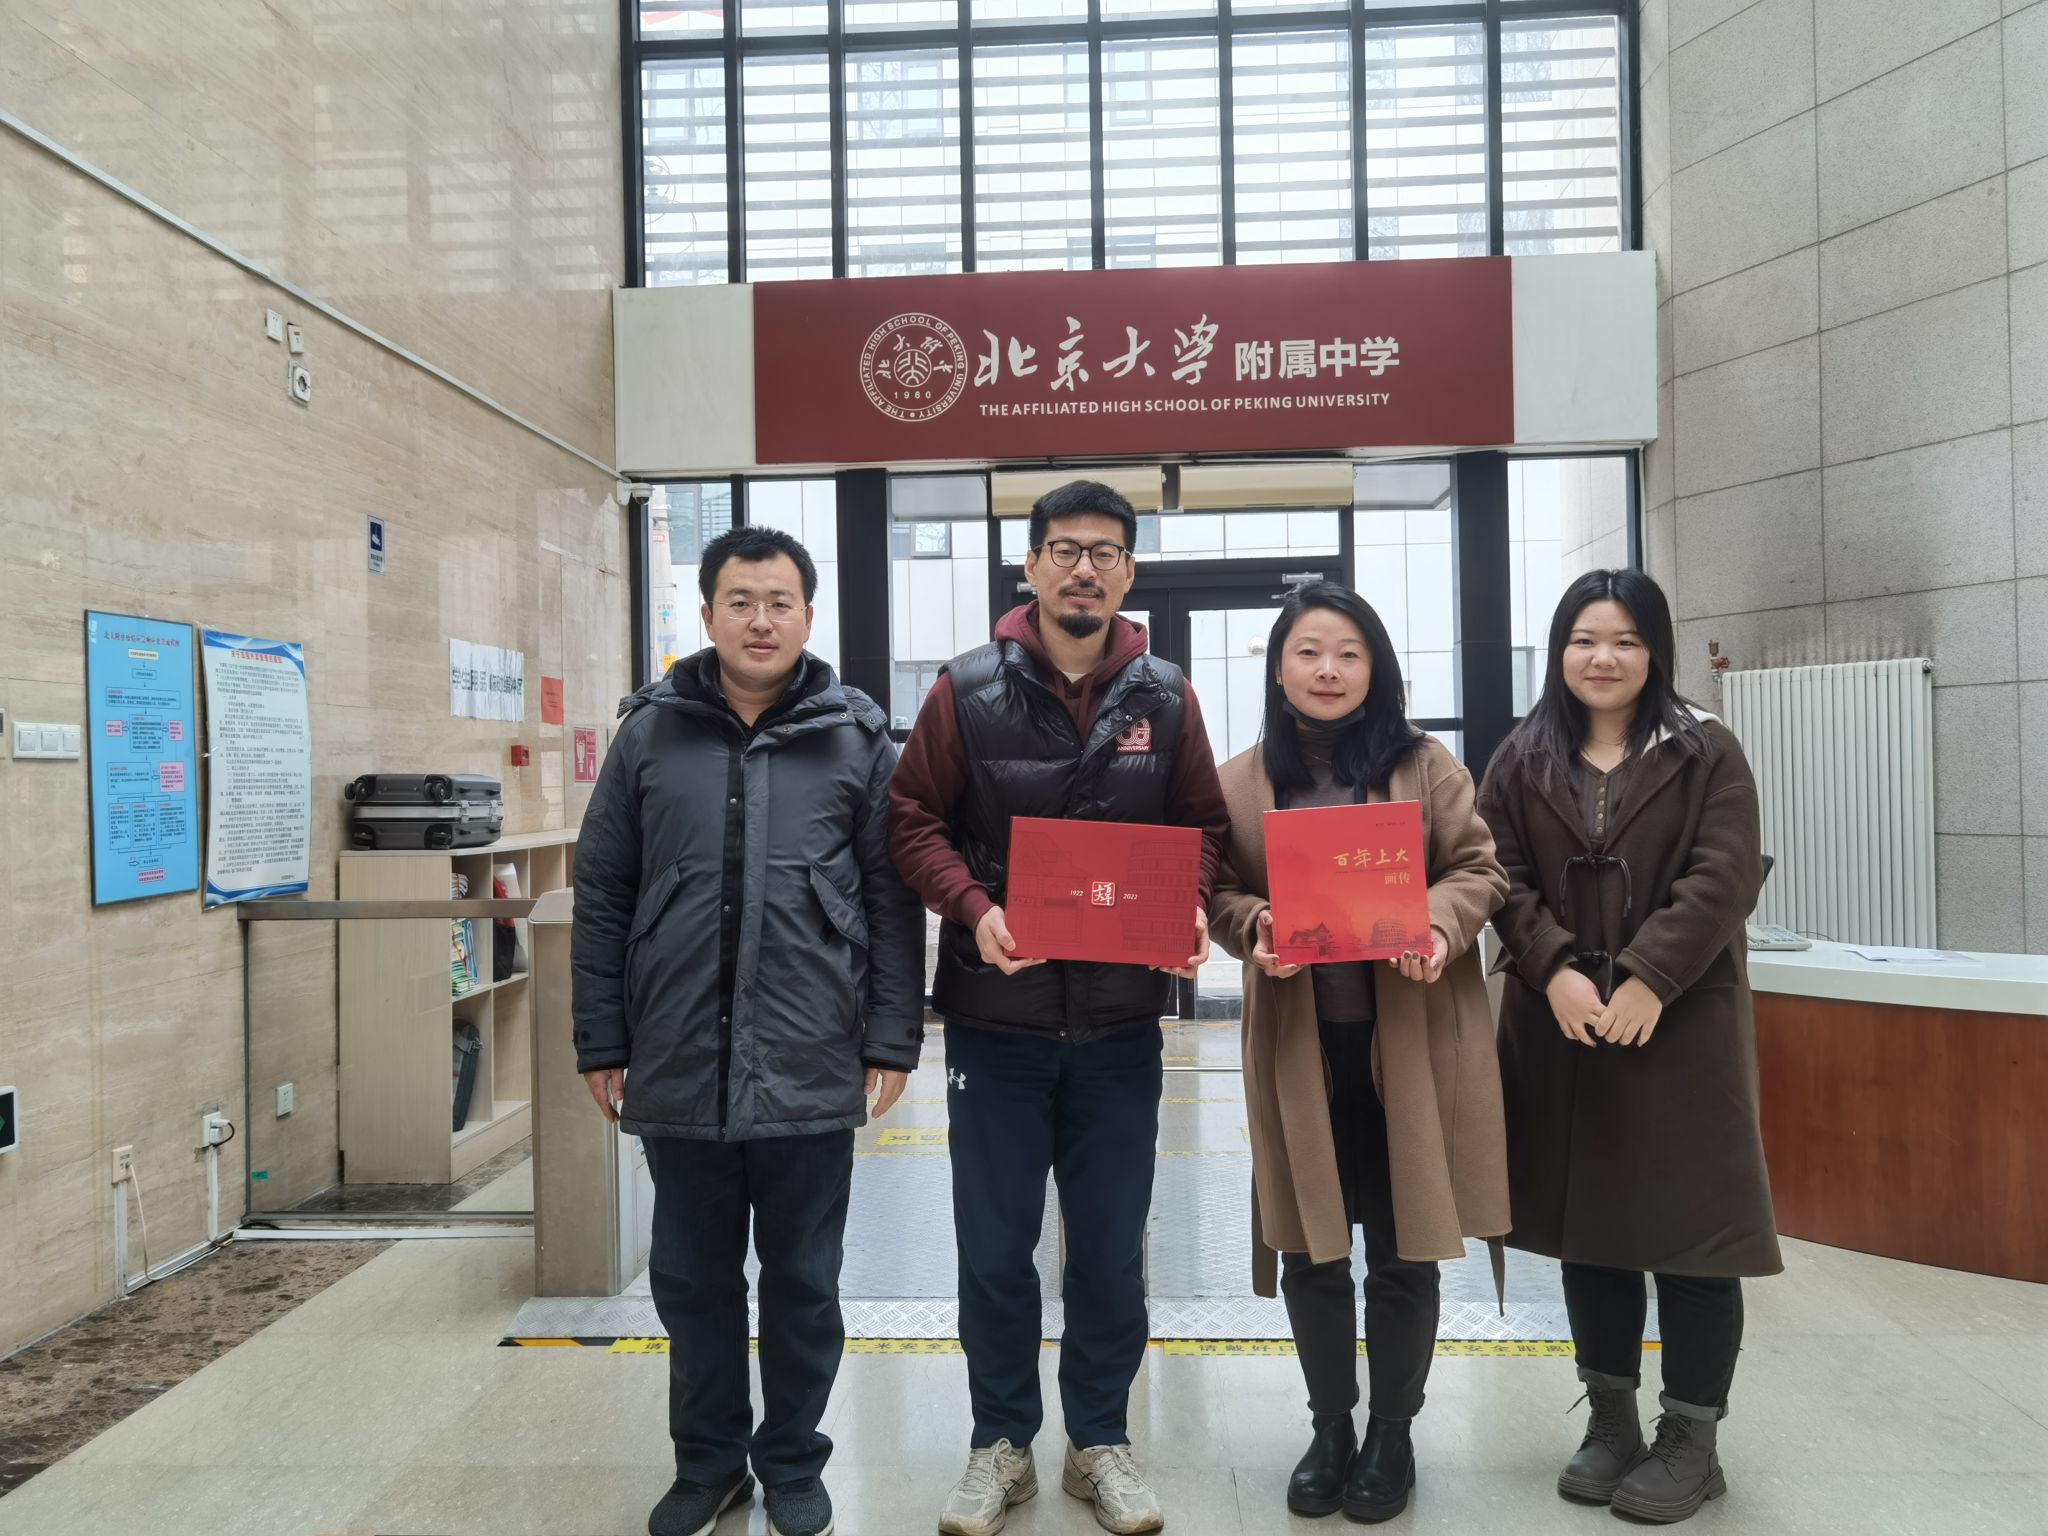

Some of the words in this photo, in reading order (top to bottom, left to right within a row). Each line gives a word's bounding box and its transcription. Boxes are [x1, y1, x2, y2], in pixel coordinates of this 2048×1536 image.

[887, 315, 932, 330] SCHOOL
[935, 322, 949, 334] OF
[868, 327, 887, 350] HIGH
[946, 332, 965, 369] PEKING
[863, 353, 885, 406] AFFILIATED
[894, 391, 931, 399] 1960
[919, 373, 964, 418] UNIVERSITY
[980, 404, 1009, 416] THE
[1011, 402, 1099, 415] AFFILIATED
[1102, 400, 1142, 412] HIGH
[1145, 398, 1208, 412] SCHOOL
[1211, 399, 1231, 411] OF
[1234, 396, 1292, 410] PEKING
[1296, 393, 1390, 408] UNIVERSITY
[884, 404, 905, 418] THE
[1333, 847, 1409, 868] 百年上大
